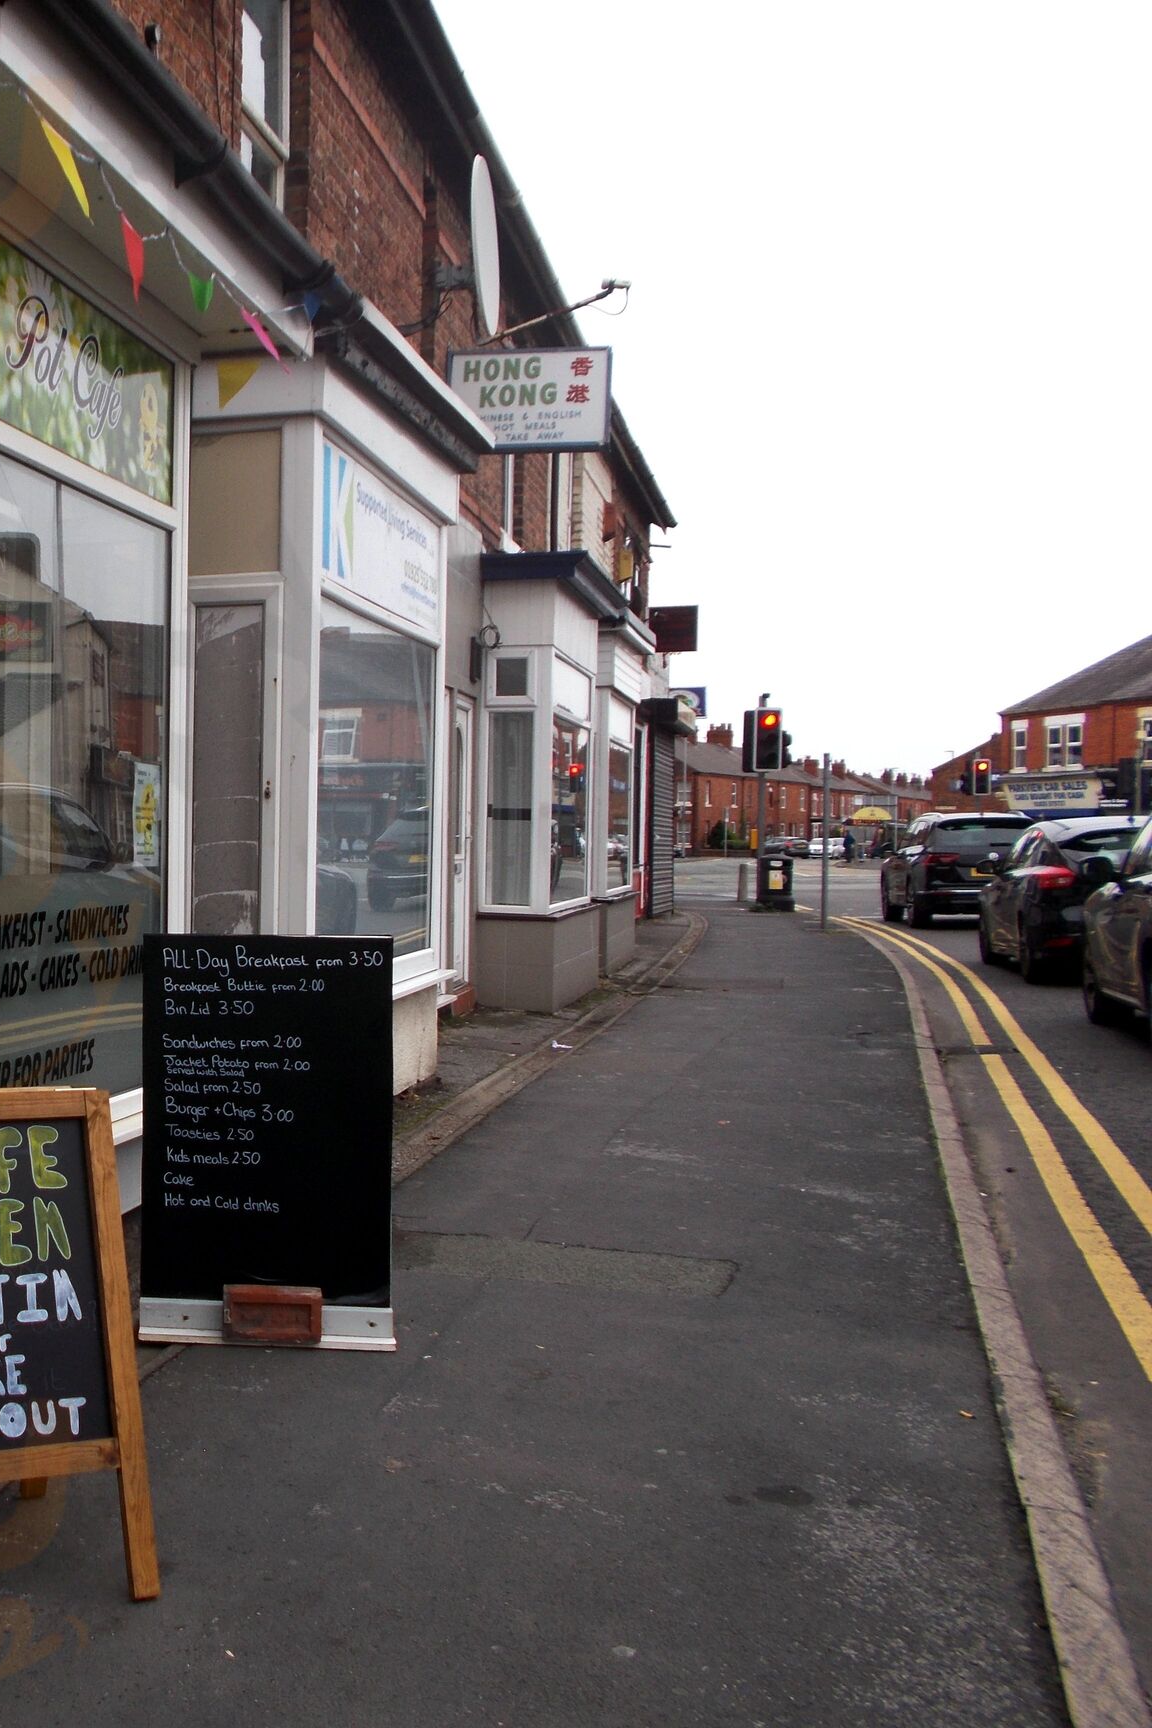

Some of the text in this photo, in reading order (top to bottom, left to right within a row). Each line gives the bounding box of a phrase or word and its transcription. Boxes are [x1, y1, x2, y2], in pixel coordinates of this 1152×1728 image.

[6, 295, 68, 393] Pot
[73, 335, 124, 440] Cafe
[463, 356, 541, 383] HONG
[479, 382, 557, 409] KONG
[480, 412, 514, 422] HINESE
[538, 410, 582, 420] ENGLISH
[494, 421, 556, 432] HOT MEALS
[506, 432, 529, 441] TAKE
[538, 431, 564, 440] AWAY
[54, 904, 130, 945] SANDWICHES
[235, 944, 309, 967] Breakfast
[316, 957, 343, 970] from
[39, 953, 80, 992] CAKES
[88, 948, 120, 984] COLD
[164, 976, 221, 994] Breakfast
[227, 978, 266, 991] Buttie
[272, 984, 296, 993] from
[165, 998, 187, 1015] Bin
[190, 1001, 210, 1015] Lid
[162, 1034, 235, 1049] Sandwiches
[240, 1039, 269, 1049] from
[13, 1052, 42, 1087] FOR
[42, 1038, 96, 1084] PARTIES
[163, 1054, 209, 1067] Jacket
[211, 1054, 250, 1069] Potato
[254, 1060, 279, 1071] from
[196, 1068, 218, 1077] with
[219, 1068, 245, 1077] Salad
[164, 1078, 199, 1094] Salad
[202, 1083, 229, 1094] from
[165, 1095, 210, 1123] Burger
[222, 1101, 256, 1121] Chips
[164, 1123, 221, 1141] Toasties
[166, 1146, 190, 1163] Kids
[193, 1152, 230, 1165] meals
[163, 1171, 195, 1186] Cake
[164, 1192, 280, 1213] Hot and Cold drinks
